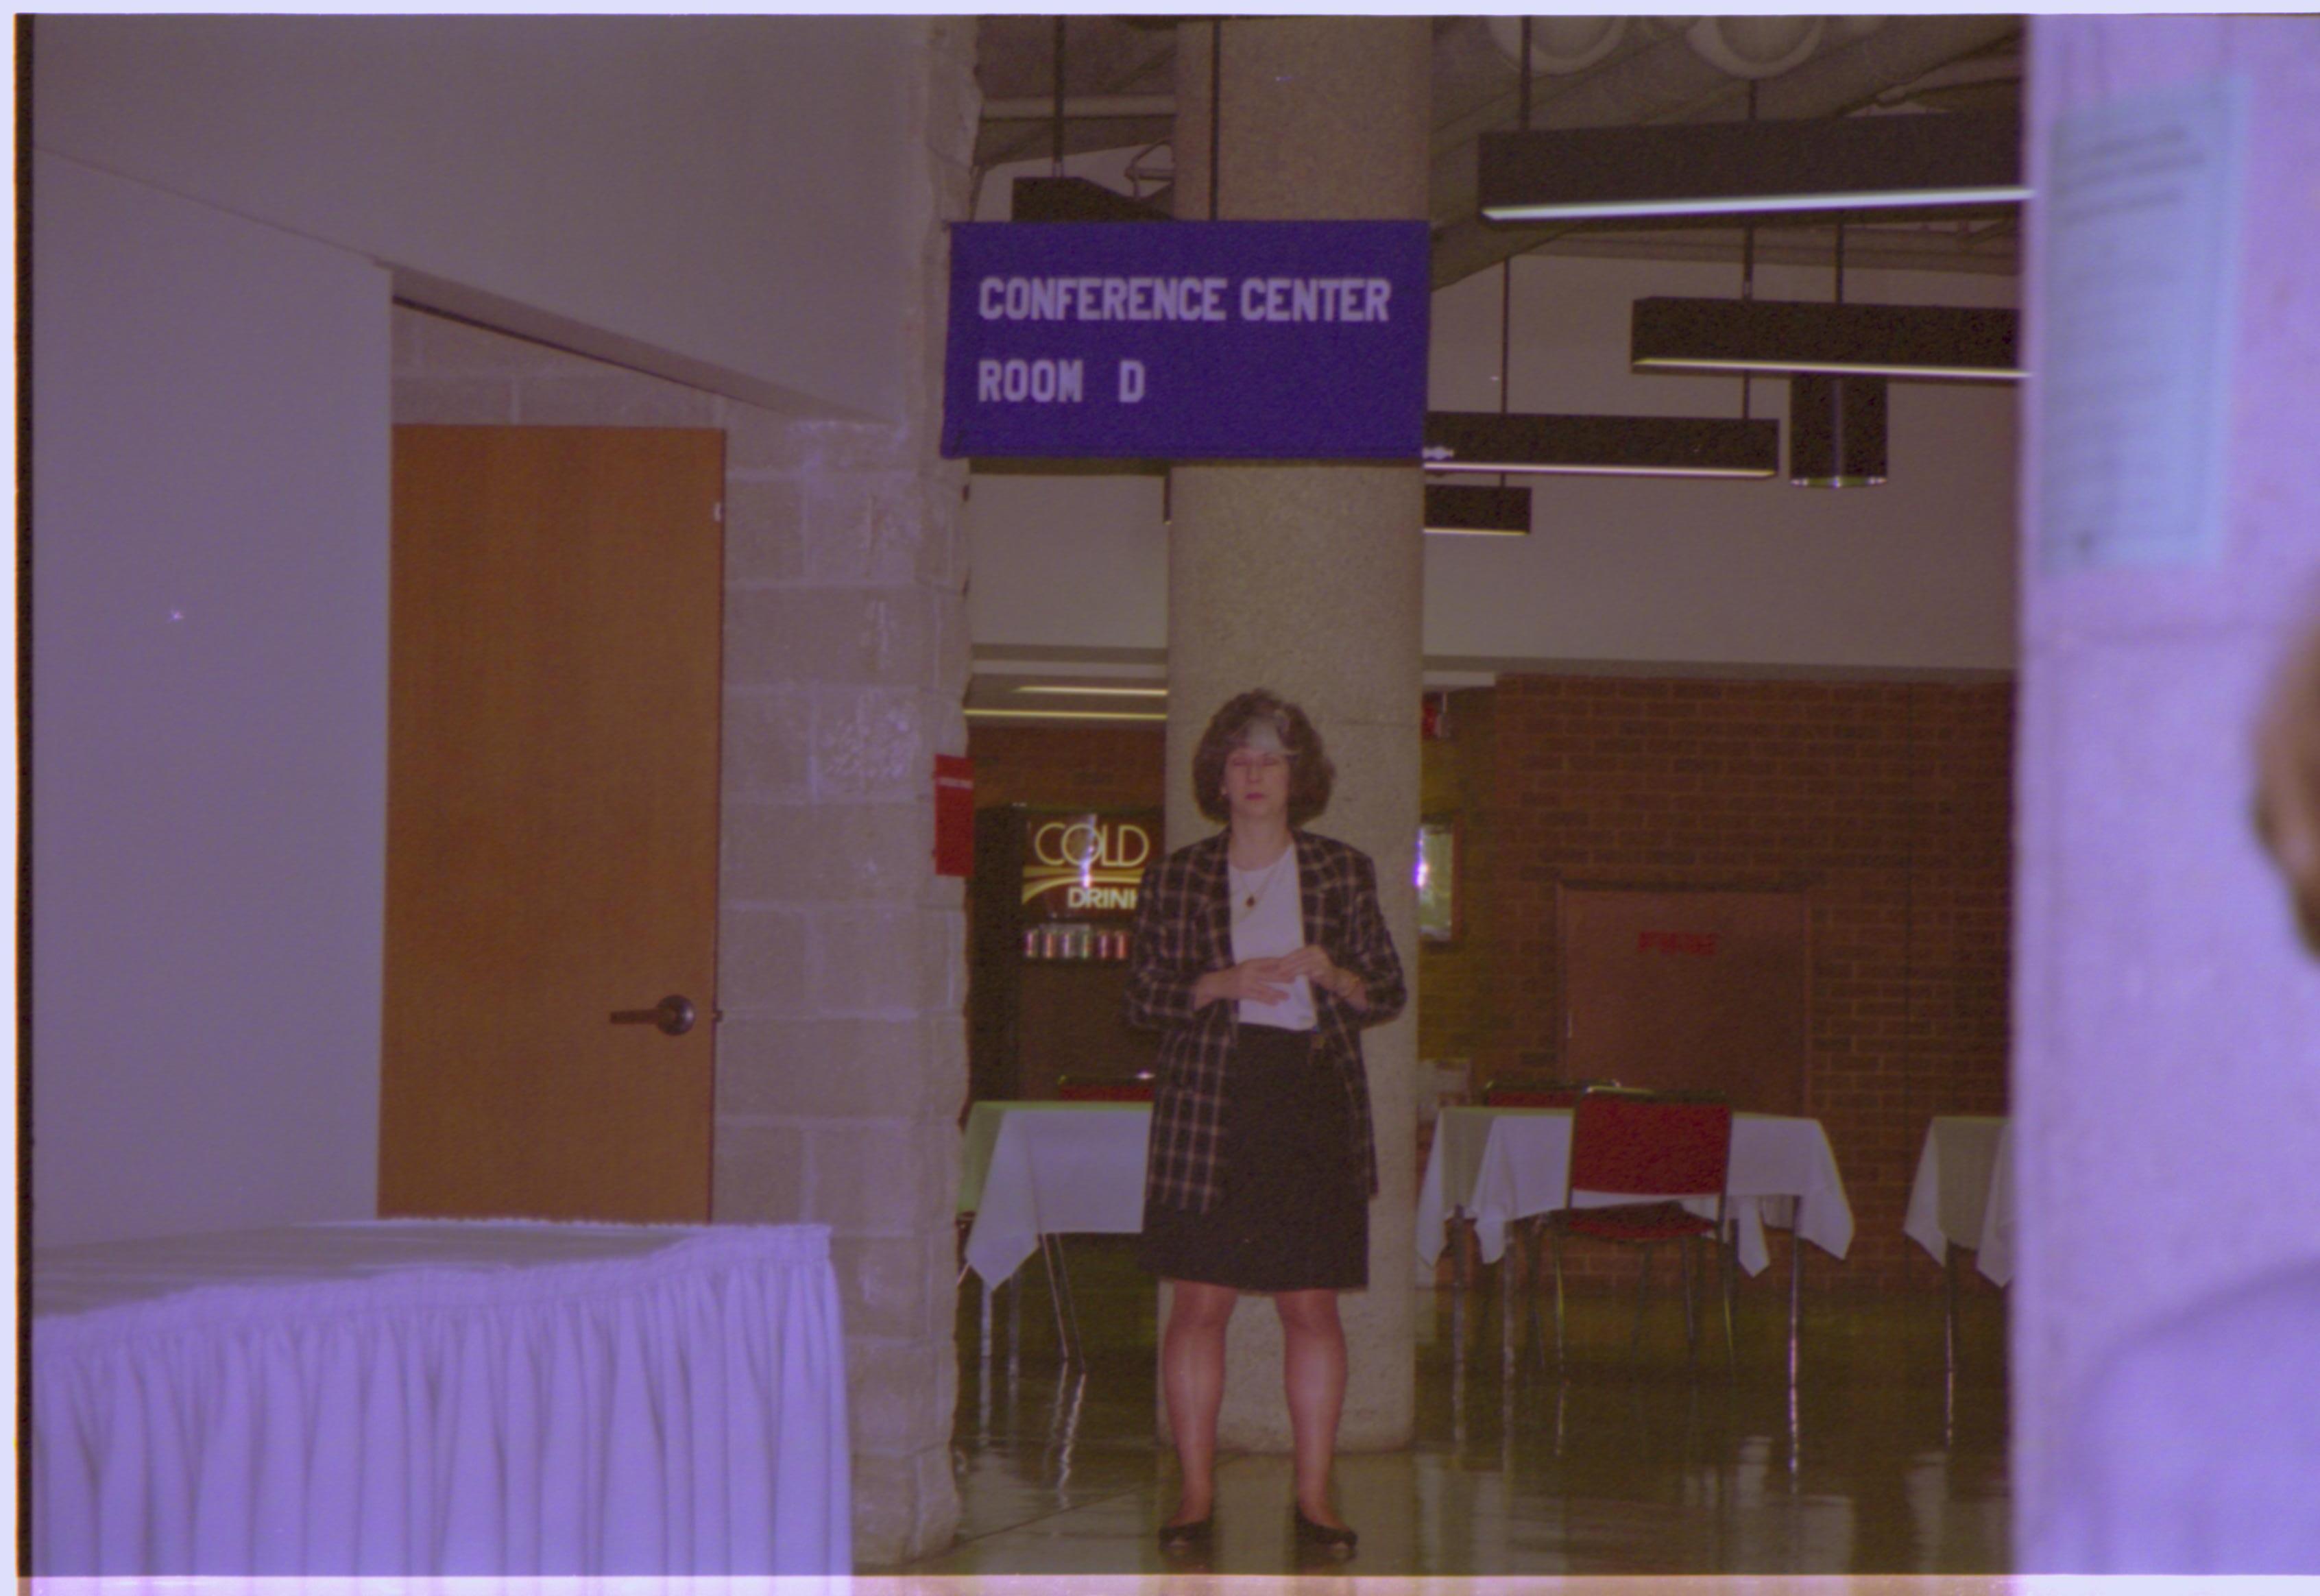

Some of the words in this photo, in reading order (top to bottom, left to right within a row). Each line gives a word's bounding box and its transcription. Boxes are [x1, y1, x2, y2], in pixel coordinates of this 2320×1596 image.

[978, 277, 1228, 321] CONFERENCE
[1240, 278, 1392, 322] CENTER
[978, 359, 1083, 403] ROOM
[1118, 359, 1146, 403] D
[1035, 822, 1150, 867] COLD
